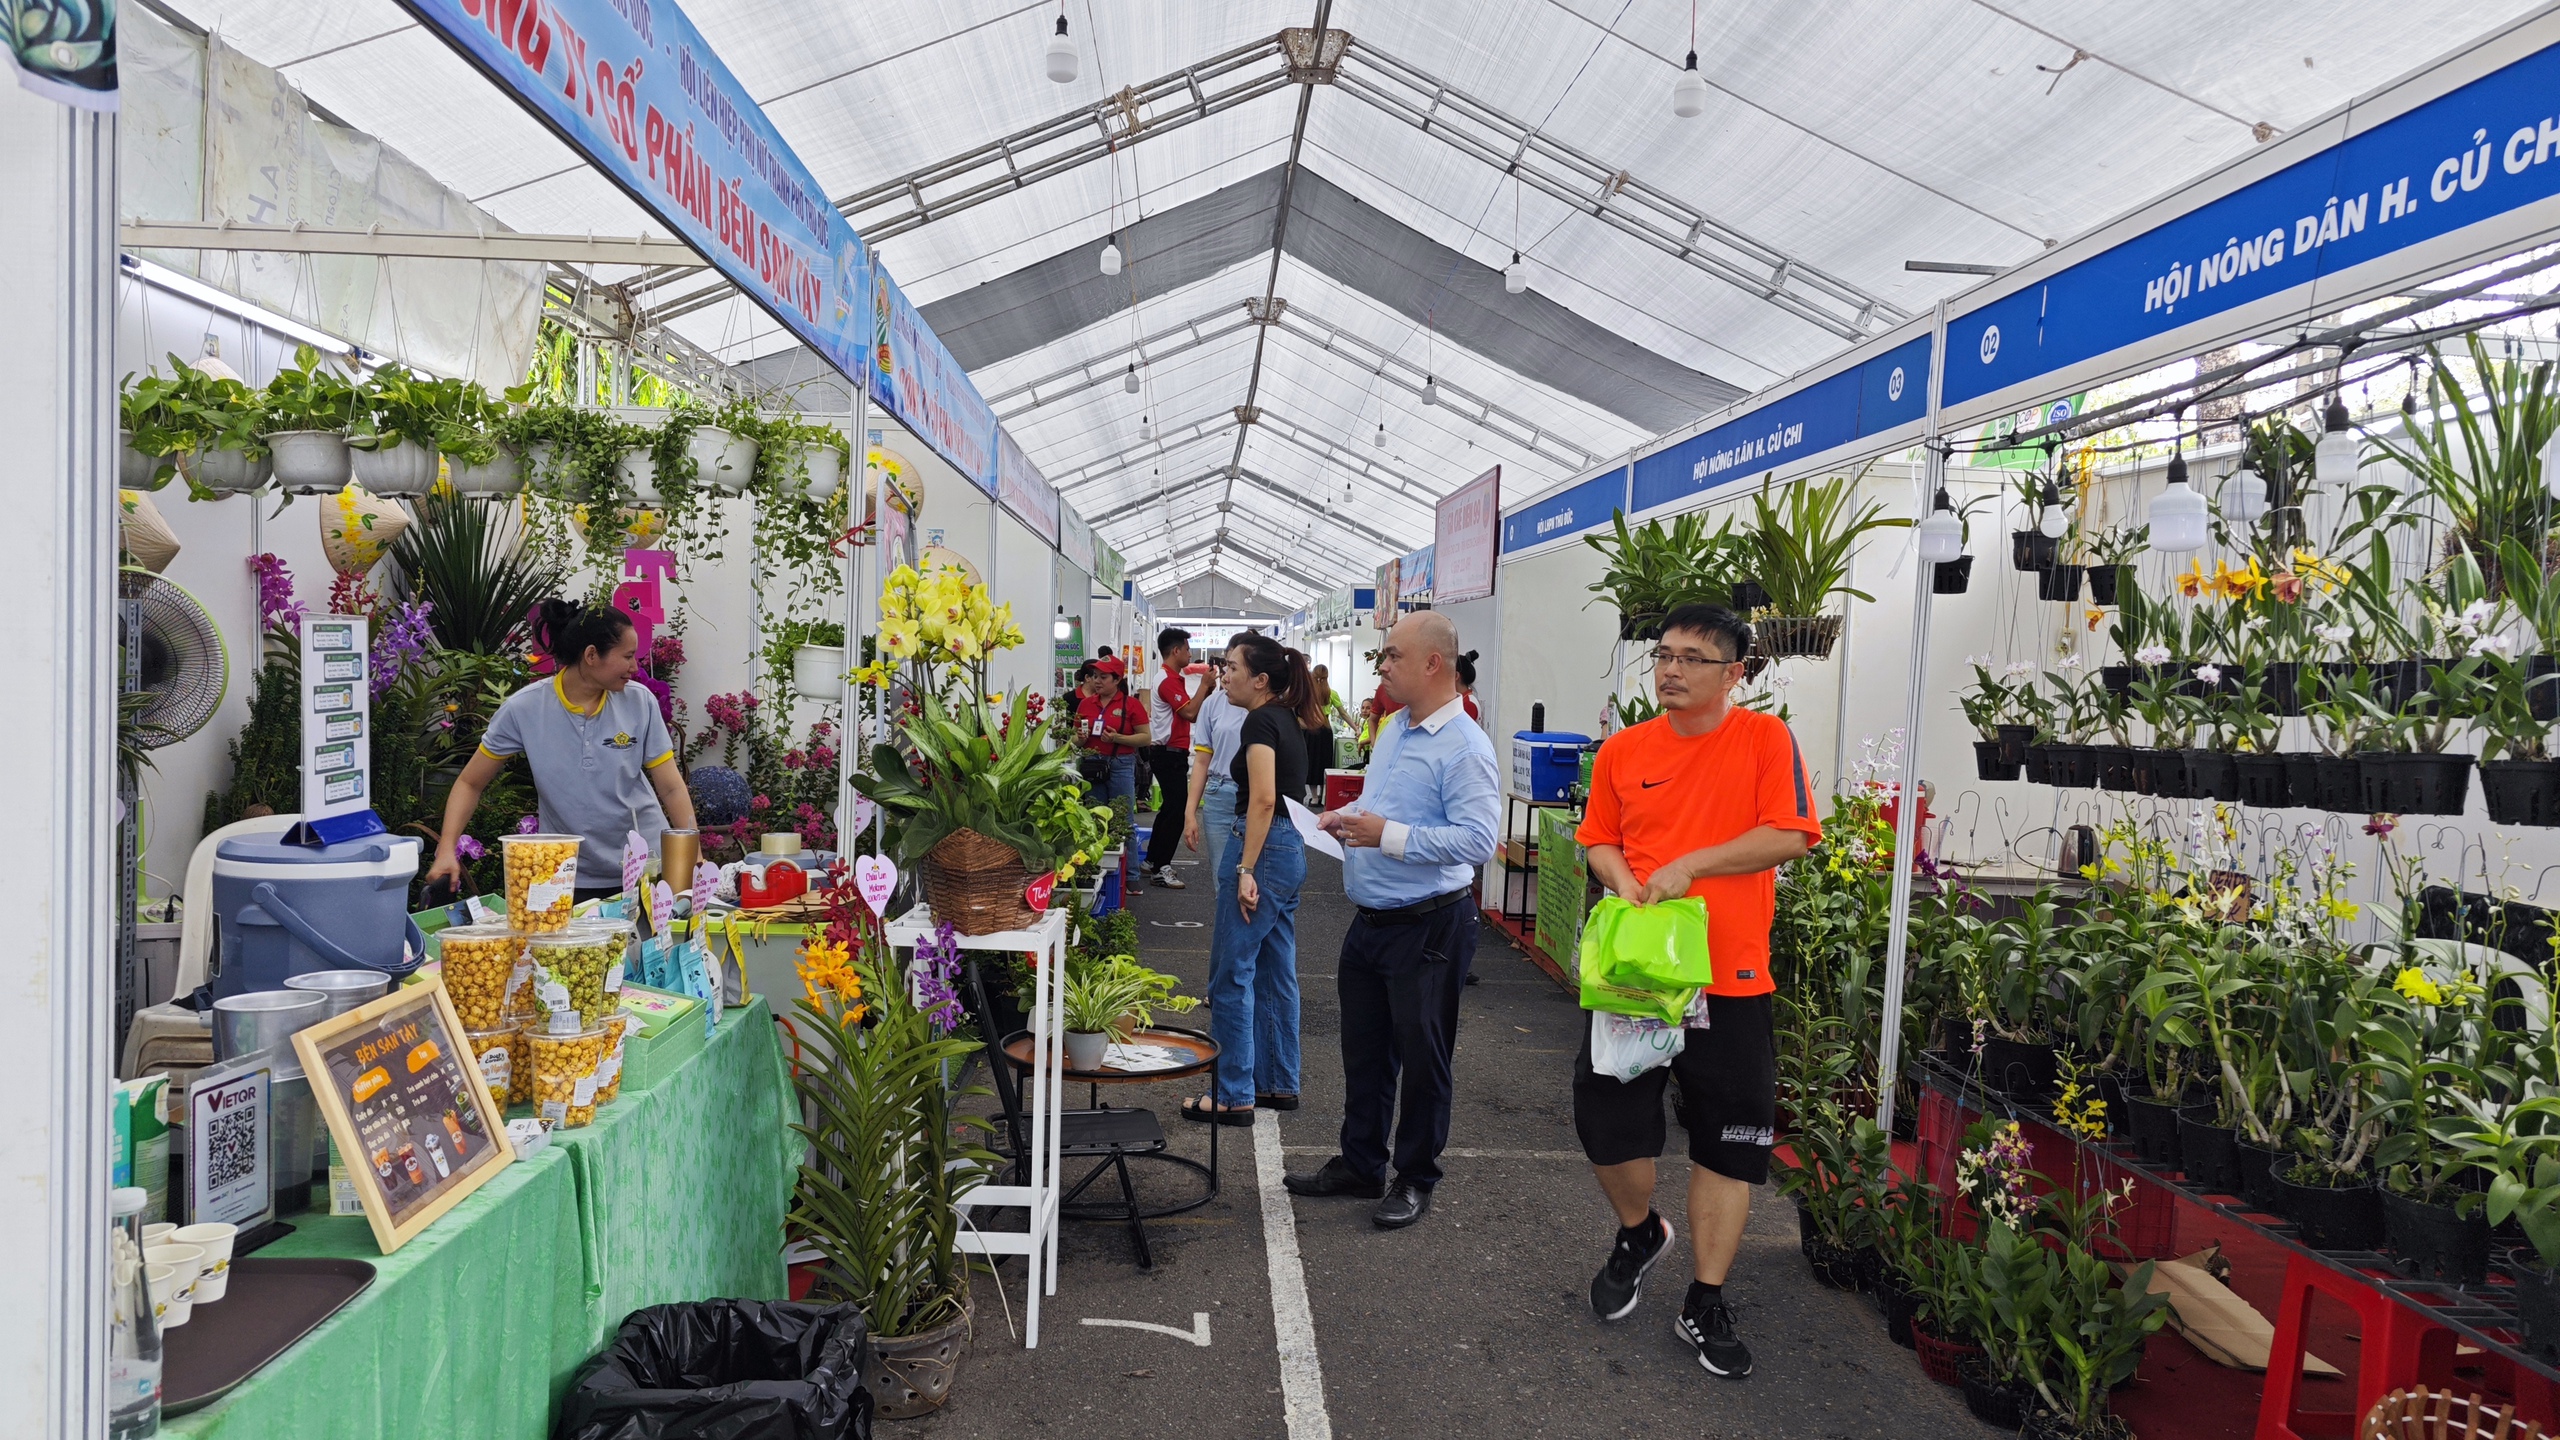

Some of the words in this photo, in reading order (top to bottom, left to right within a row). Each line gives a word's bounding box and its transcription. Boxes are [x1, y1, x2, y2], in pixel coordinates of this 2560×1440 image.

[679, 43, 696, 106] HỘI
[698, 67, 718, 126] LIÊN
[719, 94, 738, 150] HIỆP
[740, 117, 755, 176] PHỤ
[768, 154, 790, 208] THÀNH
[541, 0, 594, 118] TY
[596, 57, 643, 162] CỔ
[645, 104, 712, 231] PHẦN
[718, 177, 755, 270] BẾN
[760, 222, 793, 306] SẠN
[796, 256, 822, 328] TÂY
[2143, 260, 2193, 314] HỘI
[2197, 228, 2286, 291] NÔNG
[2293, 193, 2369, 257] DÂN
[2378, 176, 2418, 224] H.
[2430, 128, 2492, 203] CỦ
[1983, 332, 1997, 355] 02
[1890, 373, 1902, 395] 03
[2052, 409, 2067, 418] ISO
[1693, 458, 1708, 484] HỘI
[1709, 448, 1734, 474] NÔNG
[1755, 440, 1765, 459] H.
[1767, 423, 1782, 455] CỦ
[1784, 422, 1803, 448] CHI
[355, 1081, 372, 1093] Coffee
[1721, 1133, 1757, 1141] SPORT
